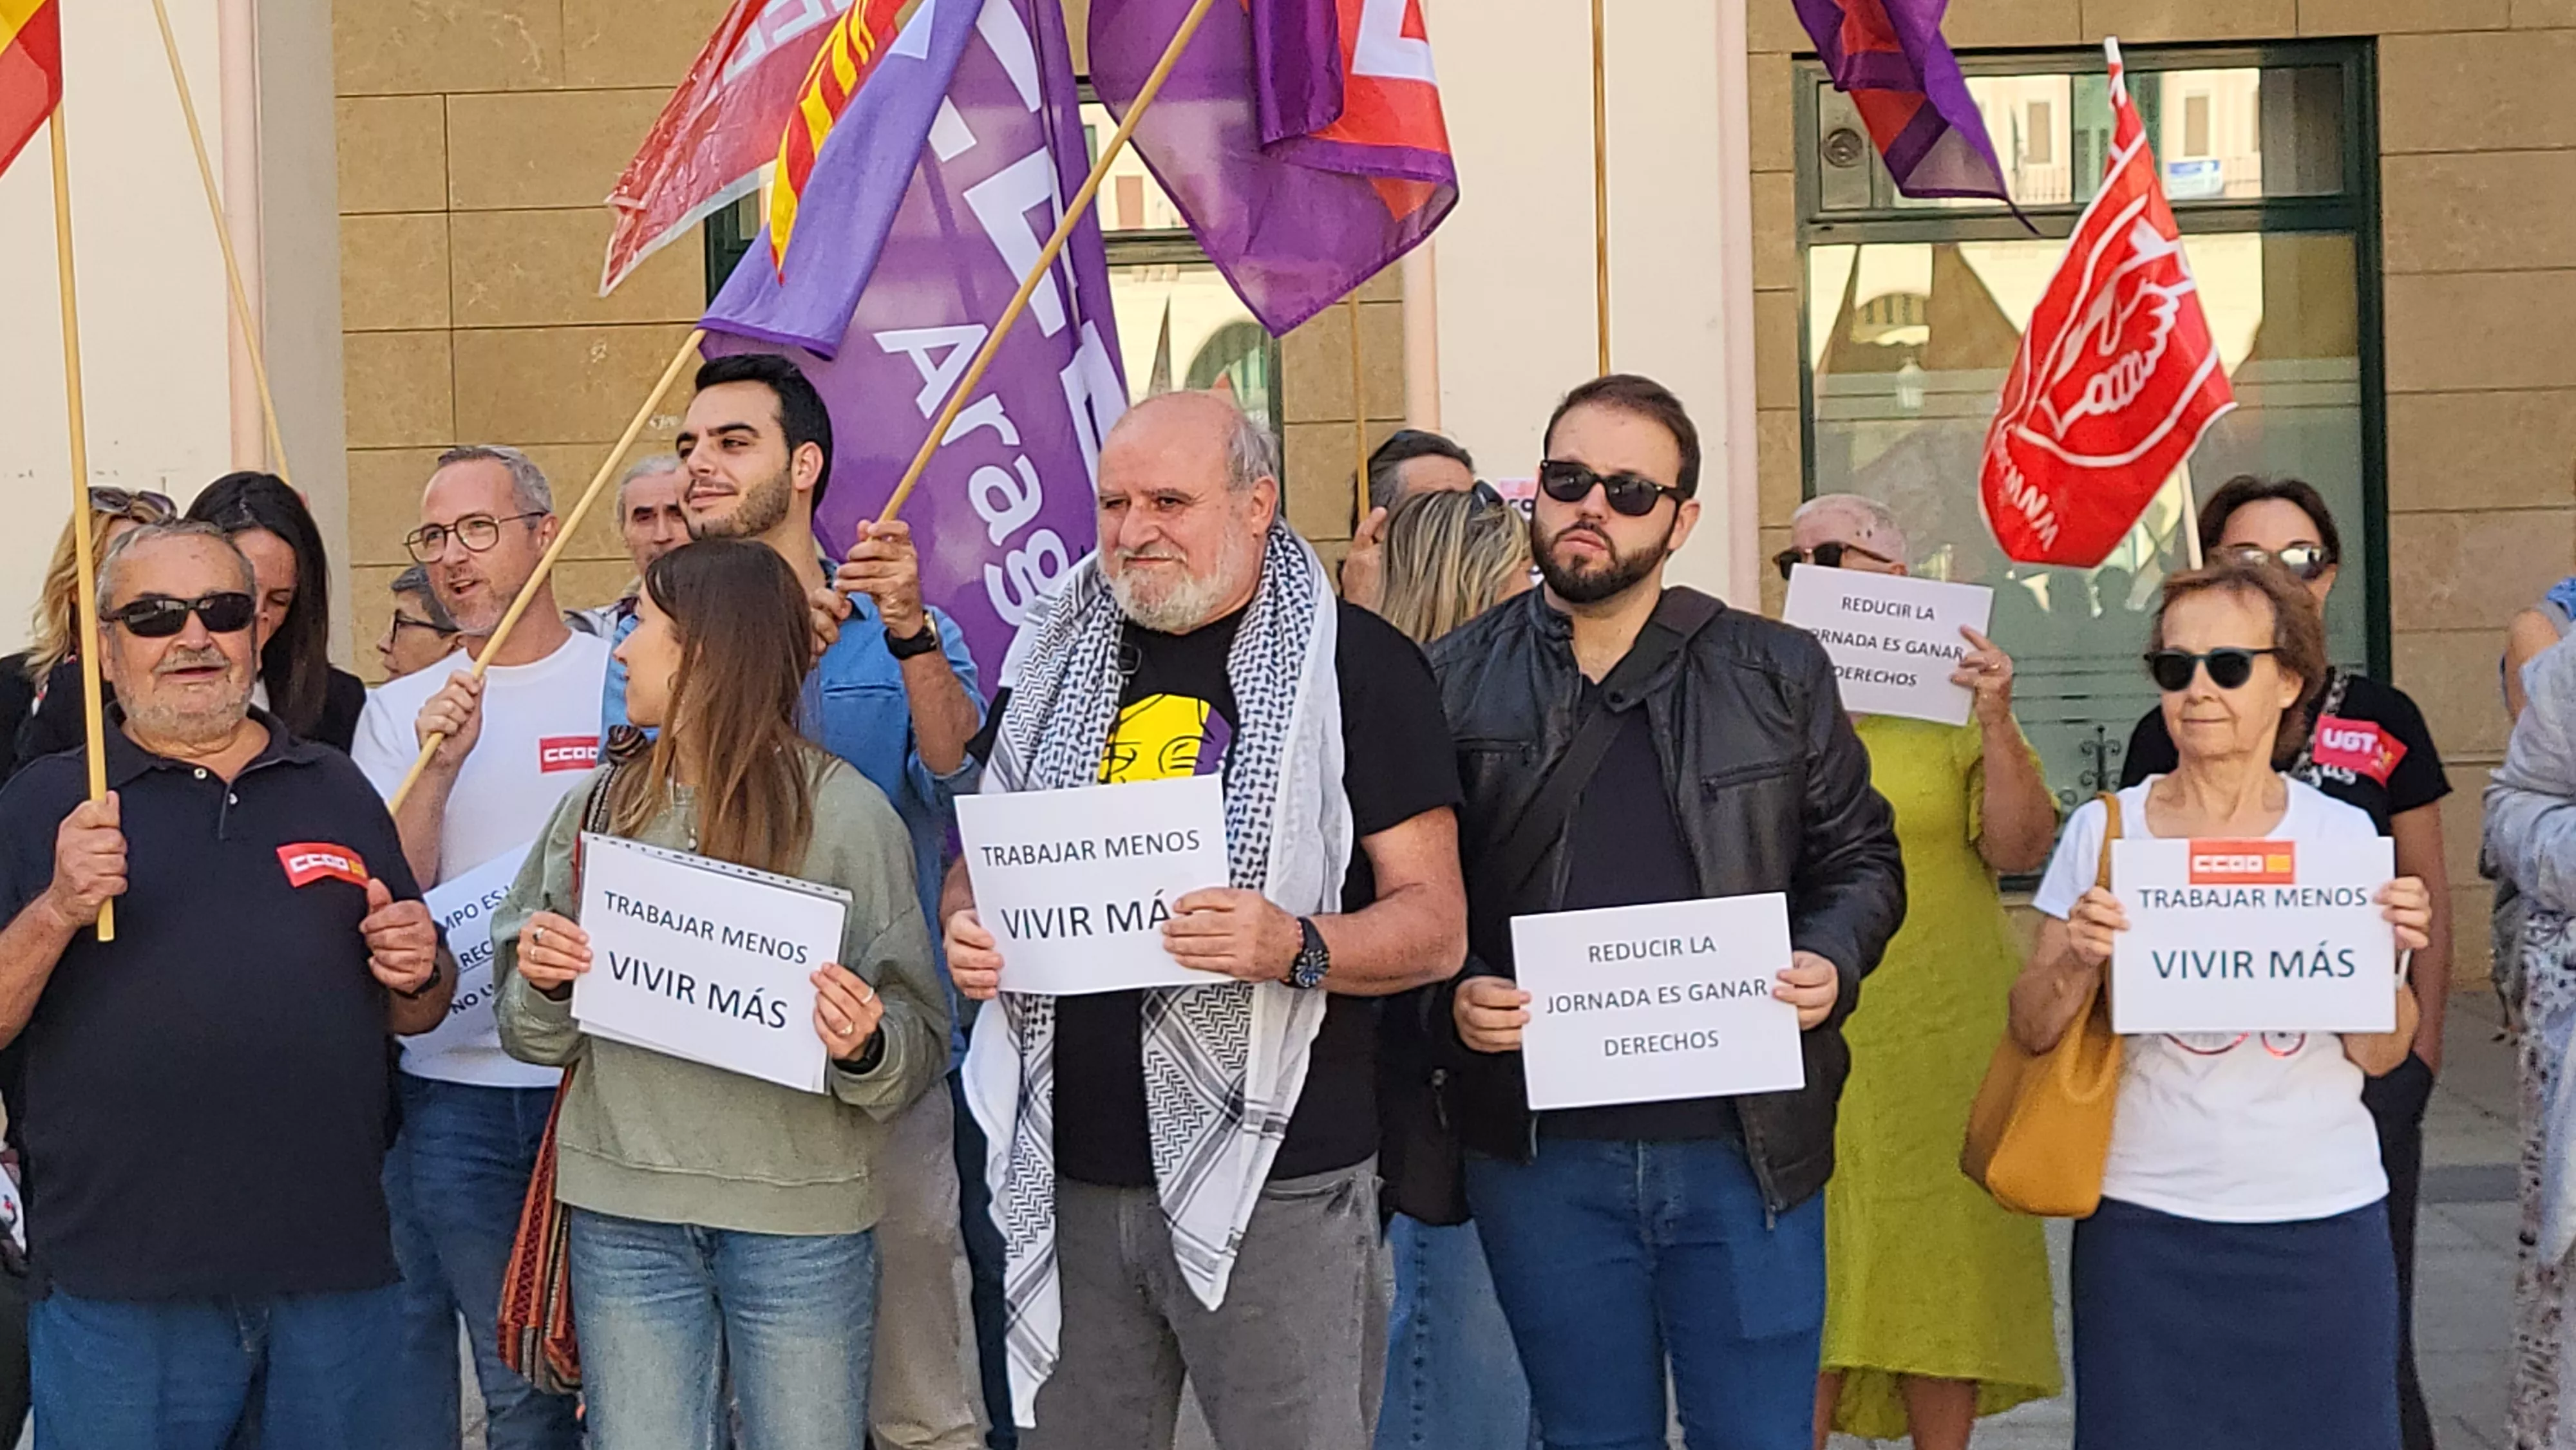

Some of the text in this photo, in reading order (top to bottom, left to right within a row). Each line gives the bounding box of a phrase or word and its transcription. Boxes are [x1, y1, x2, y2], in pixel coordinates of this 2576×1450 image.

[1842, 596, 1935, 621] REDUCIR LA
[1810, 628, 1964, 659] ORNADA ES GANAR
[1834, 666, 1917, 687] DERECHOS
[544, 747, 599, 762] CCOO
[2322, 728, 2378, 754] UGT
[981, 830, 1199, 867] TRABAJAR MENOS
[289, 853, 349, 873] CCOO
[2193, 854, 2264, 873] CCOO
[2137, 887, 2367, 909] TRABAJAR MENOS
[604, 890, 808, 965] TRABAJAR MENOS
[1001, 889, 1171, 939] VIVIR MÁ
[1589, 936, 1716, 963] REDUCIR LA
[2152, 941, 2355, 979] VIVIR MÁS
[609, 951, 788, 1029] VIVIR MÁS
[1547, 978, 1768, 1014] JORNADA ES GANAR
[1604, 1030, 1719, 1057] DERECHOS
